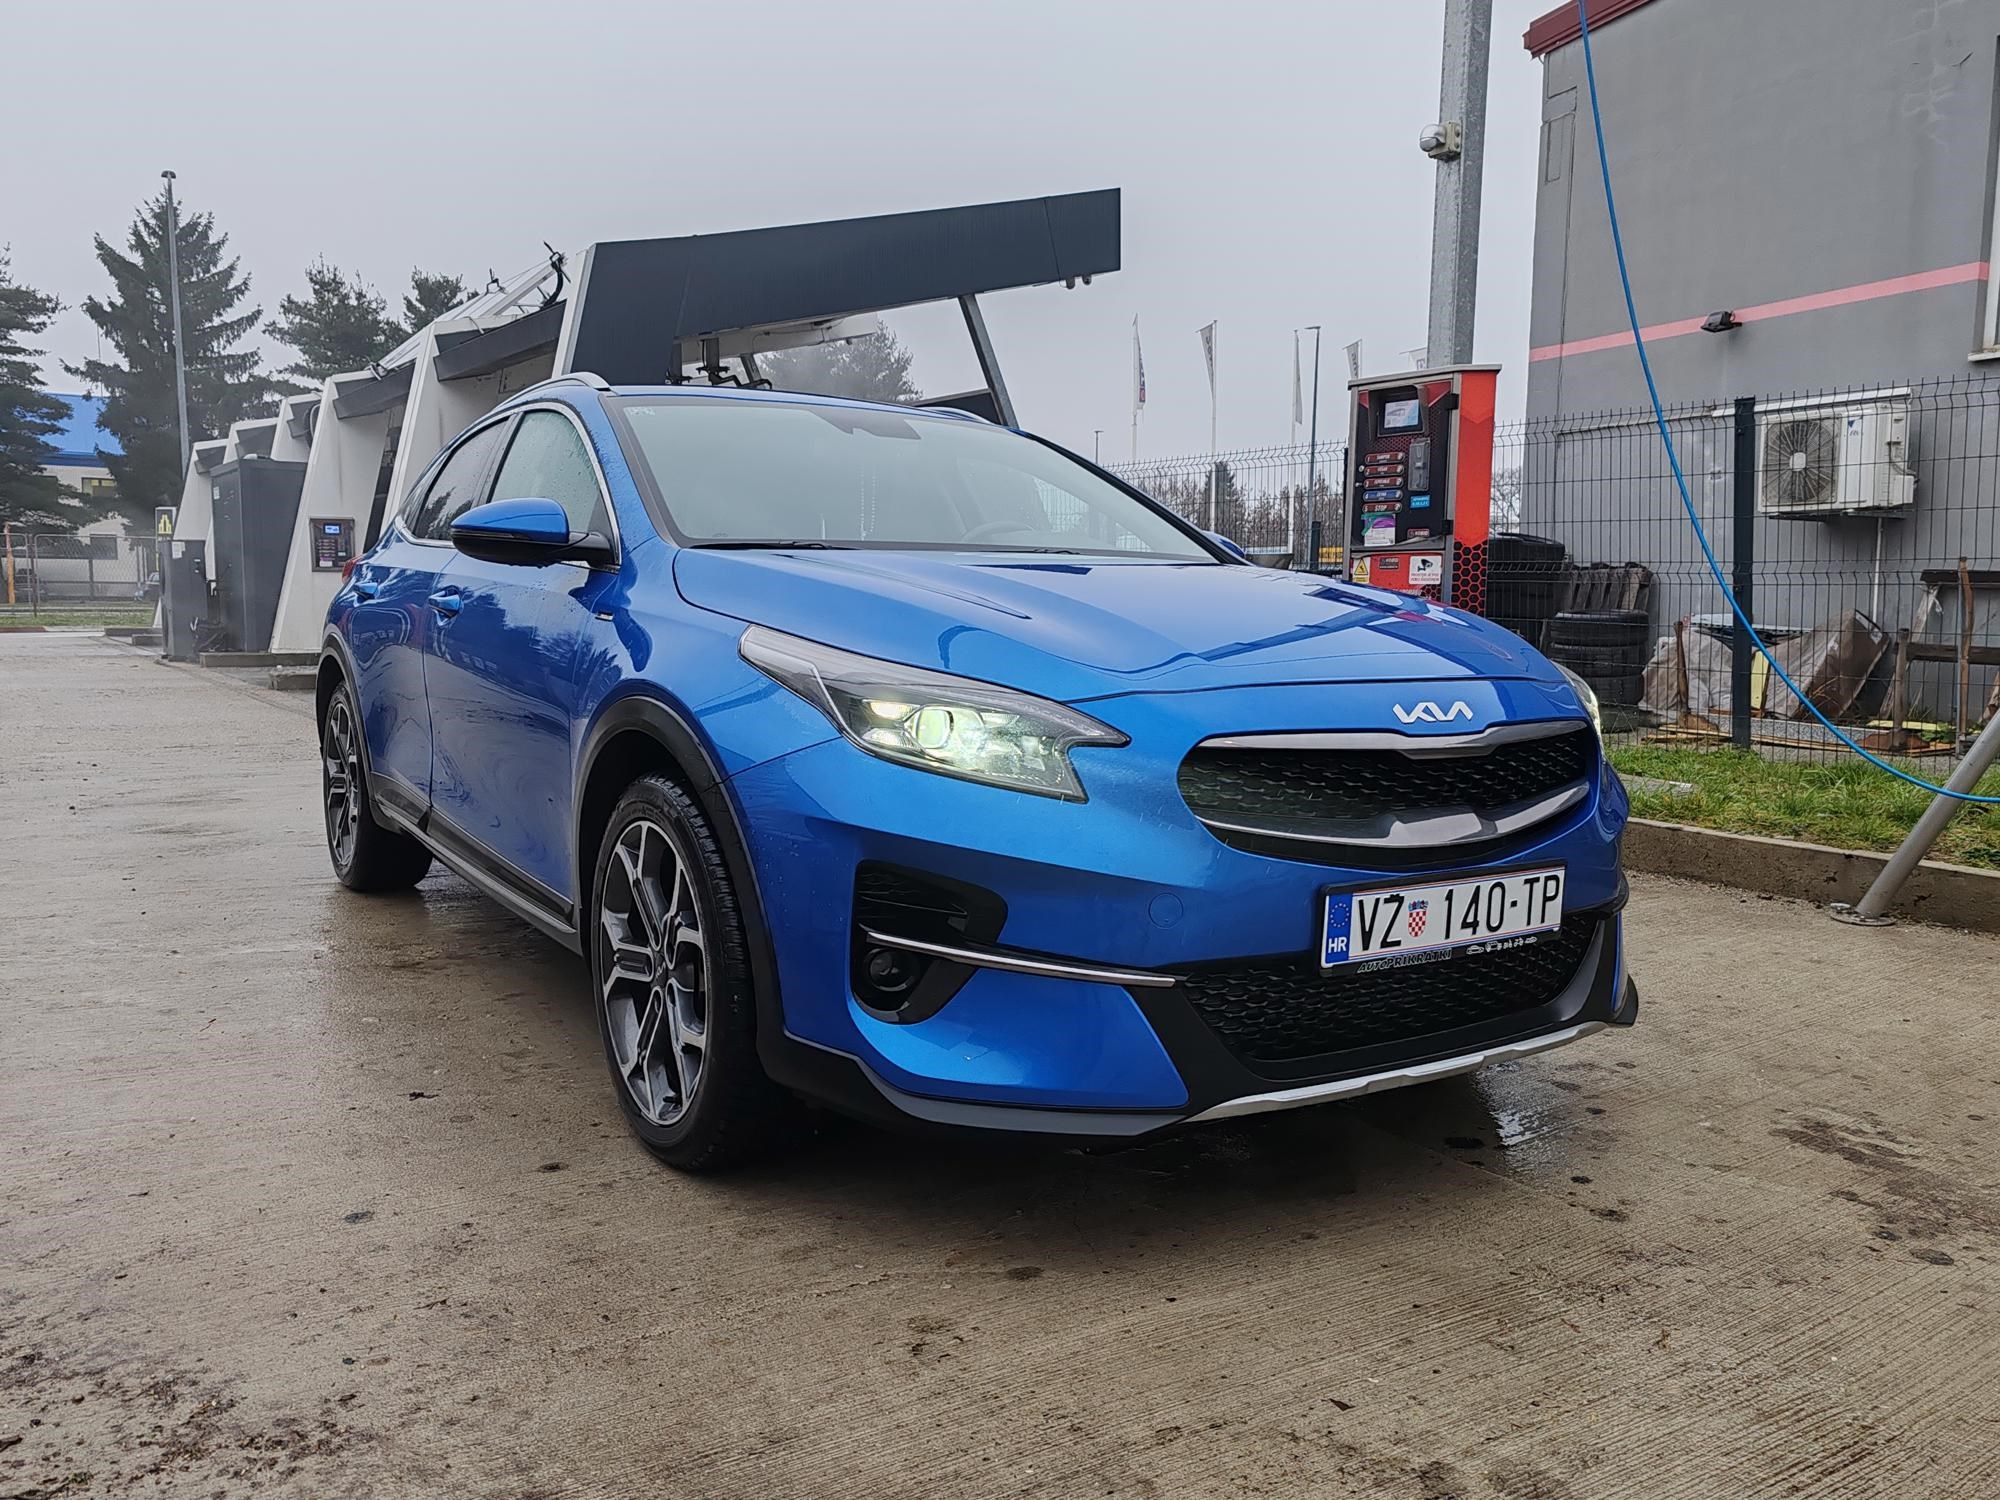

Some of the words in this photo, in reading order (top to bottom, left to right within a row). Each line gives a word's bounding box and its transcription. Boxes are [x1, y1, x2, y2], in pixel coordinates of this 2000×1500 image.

[1374, 504, 1388, 512] STOP
[1392, 701, 1474, 724] KIA
[1358, 893, 1405, 951] VŽ
[1444, 874, 1560, 940] 140-TP
[1328, 936, 1347, 953] HR
[1356, 948, 1453, 973] AUTOPRIKRATKI
